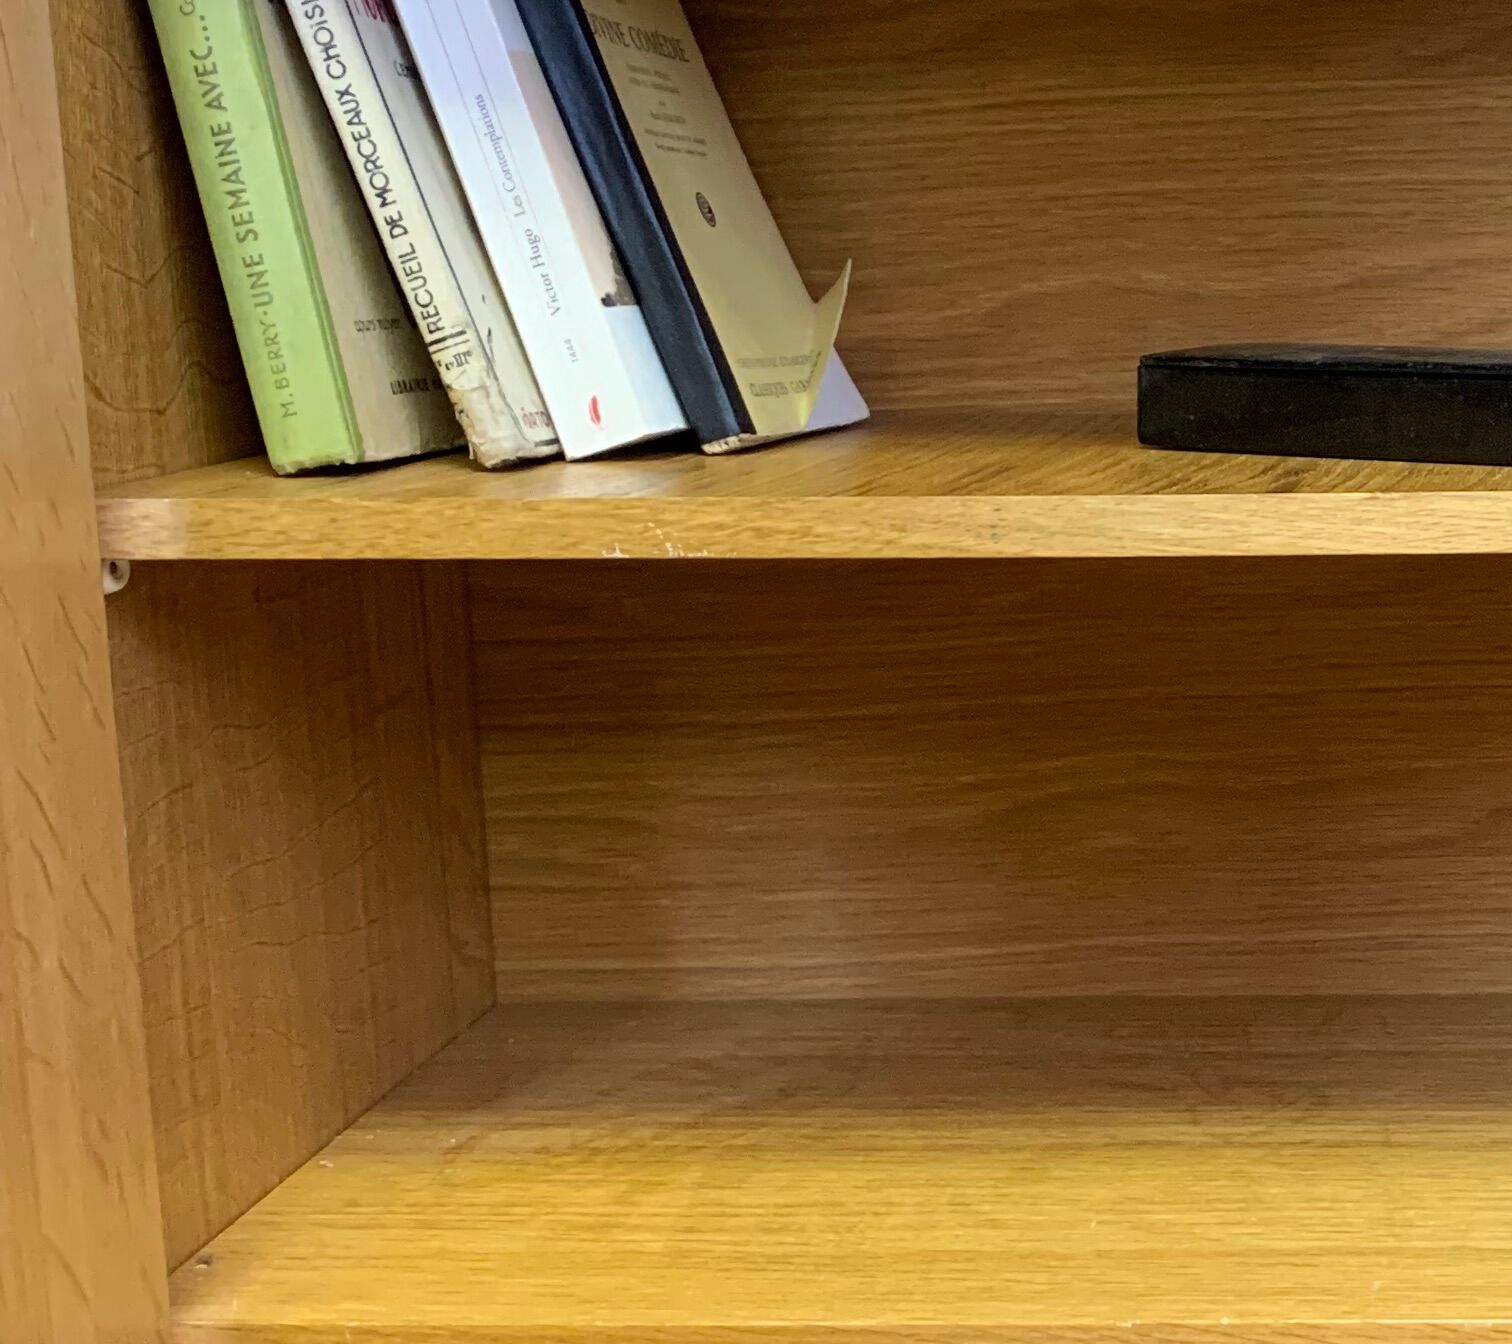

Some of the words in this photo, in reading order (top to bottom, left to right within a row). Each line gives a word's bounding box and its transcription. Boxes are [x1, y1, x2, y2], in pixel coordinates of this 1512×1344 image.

[333, 81, 398, 211] MORCEAUX
[474, 92, 518, 194] Contemplations
[210, 120, 259, 246] SEMAINE
[512, 194, 528, 218] Les
[383, 210, 410, 241] DE
[523, 227, 546, 270] Hugo
[397, 241, 447, 336] RECUEIL
[540, 272, 562, 318] Victor
